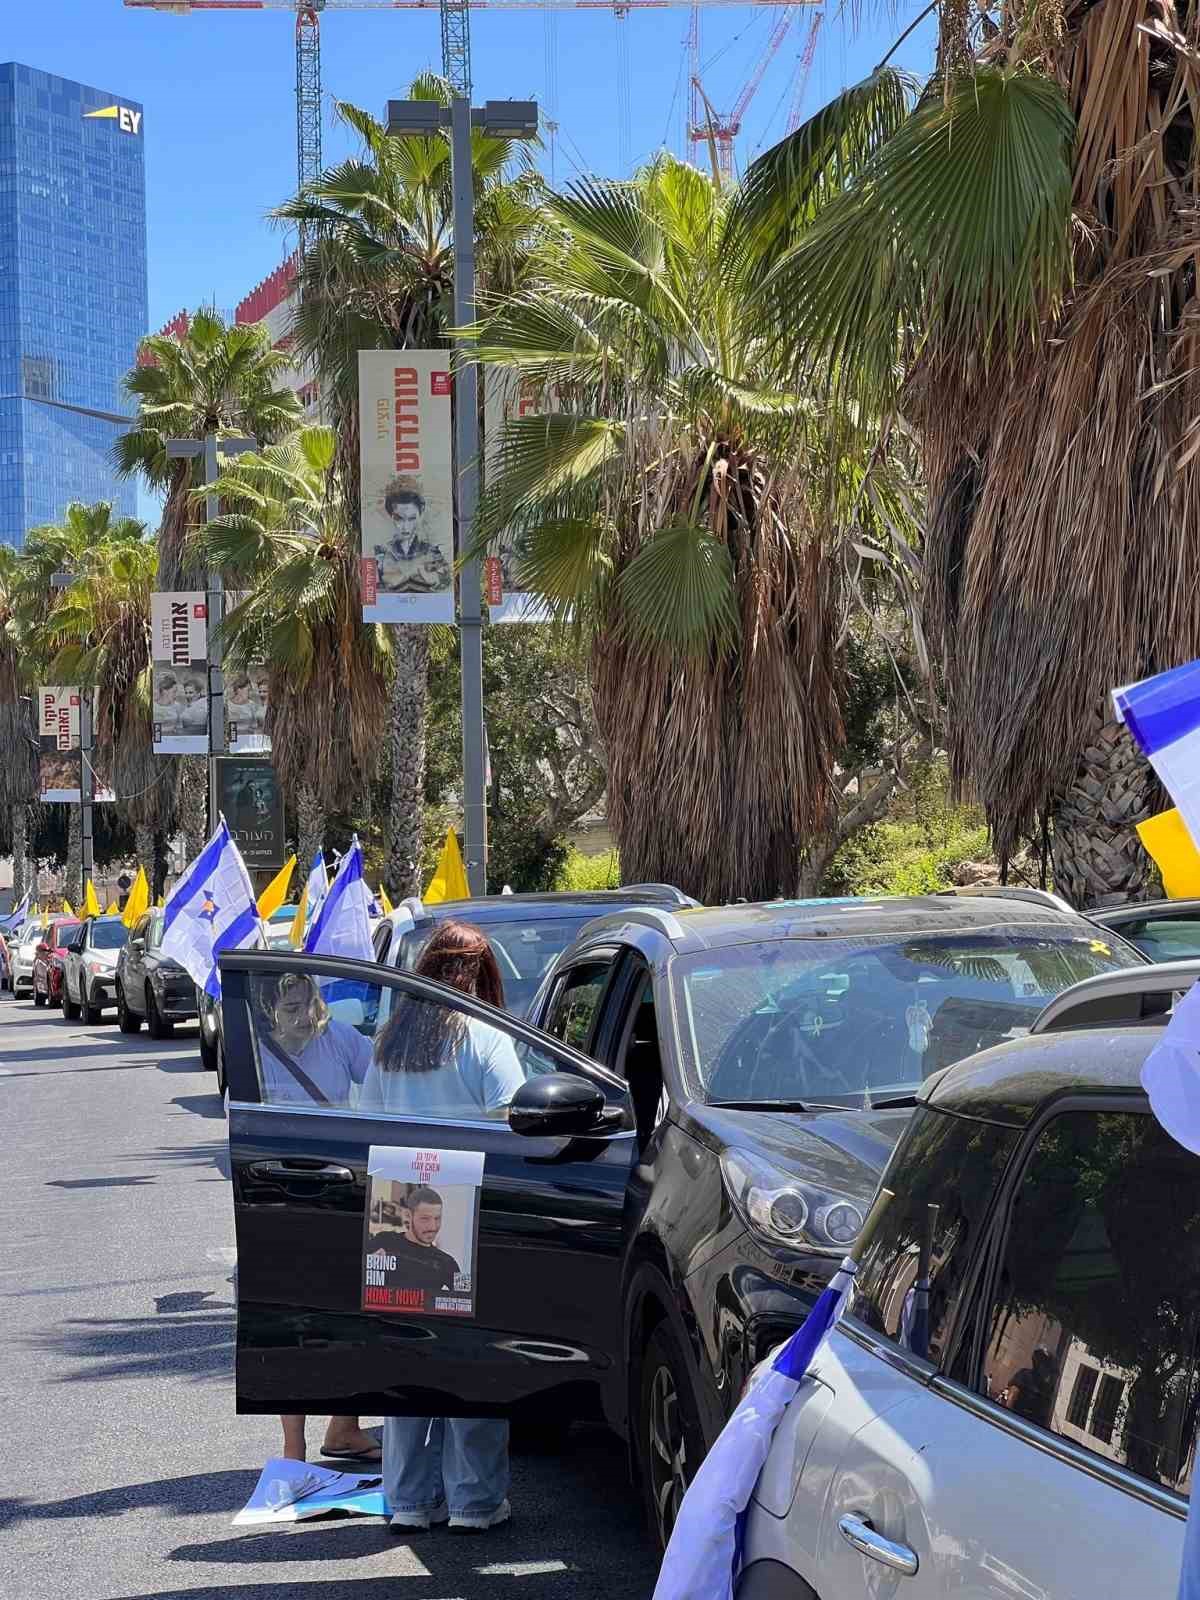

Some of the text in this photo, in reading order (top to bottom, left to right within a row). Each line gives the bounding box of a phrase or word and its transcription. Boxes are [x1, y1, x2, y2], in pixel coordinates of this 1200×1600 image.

[119, 106, 141, 135] EY
[394, 367, 421, 472] טורנדוט
[172, 602, 189, 665] אמהות
[44, 694, 57, 728] שיקוי
[58, 707, 70, 749] האהבה
[425, 1162, 441, 1172] CHEN
[366, 1254, 397, 1271] BRING
[366, 1270, 385, 1286] HIM
[365, 1286, 425, 1305] HOME NOW!
